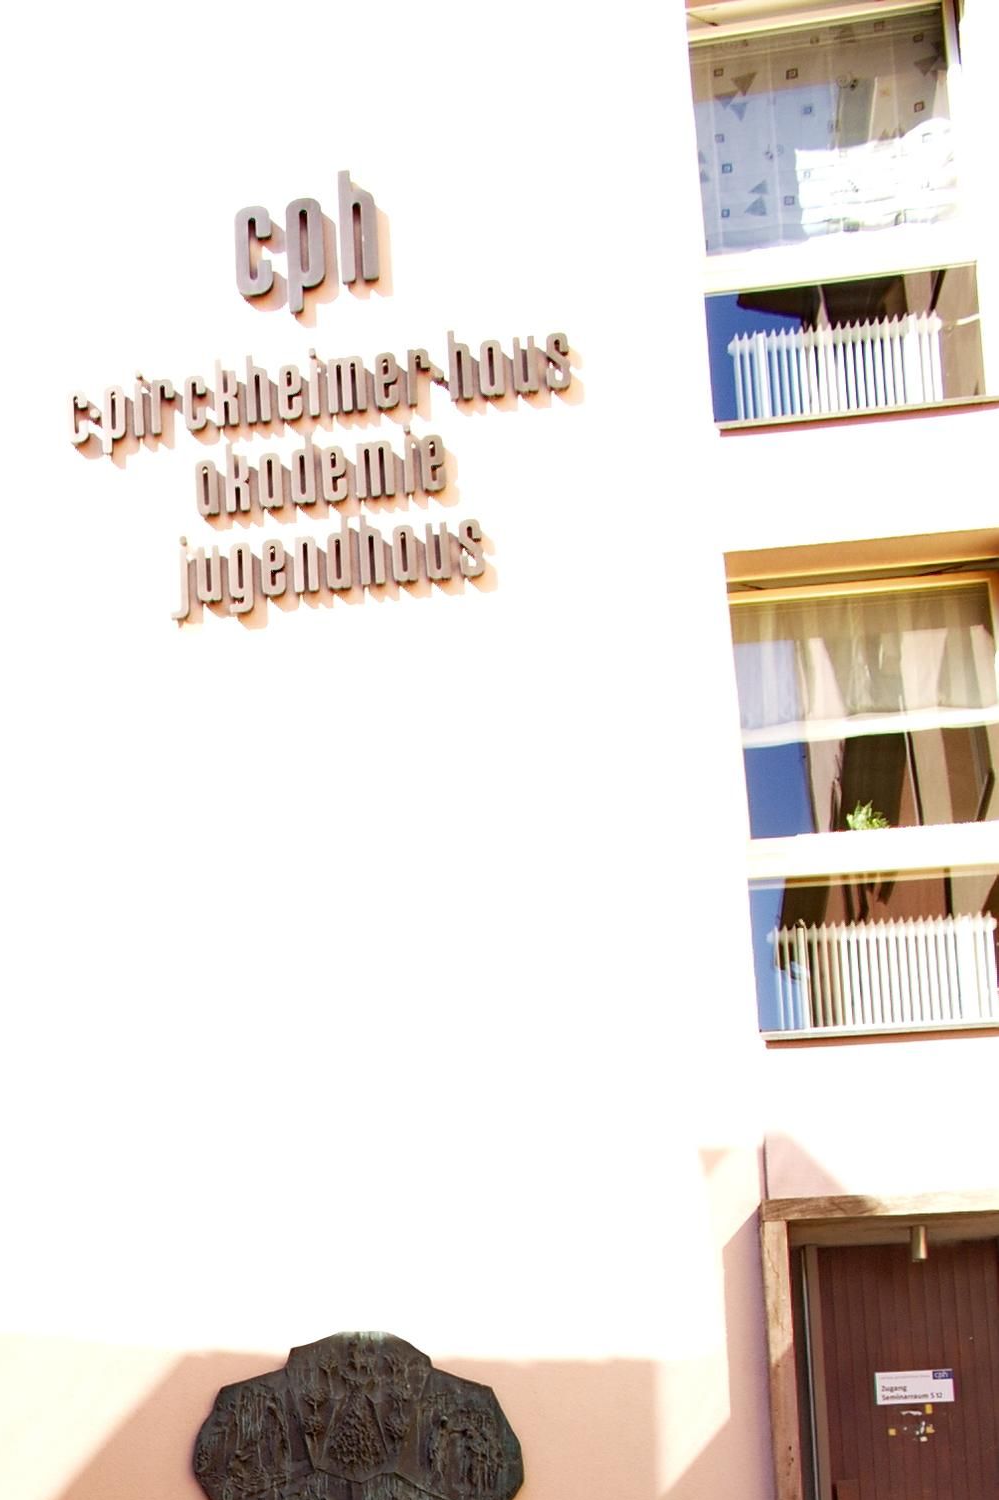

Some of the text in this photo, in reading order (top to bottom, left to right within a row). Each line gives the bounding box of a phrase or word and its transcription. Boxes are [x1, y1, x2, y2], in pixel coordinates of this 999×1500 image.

[234, 170, 380, 314] cph
[195, 424, 446, 515] akademie
[171, 515, 486, 621] jugendhaus
[881, 1385, 907, 1393] Zugang
